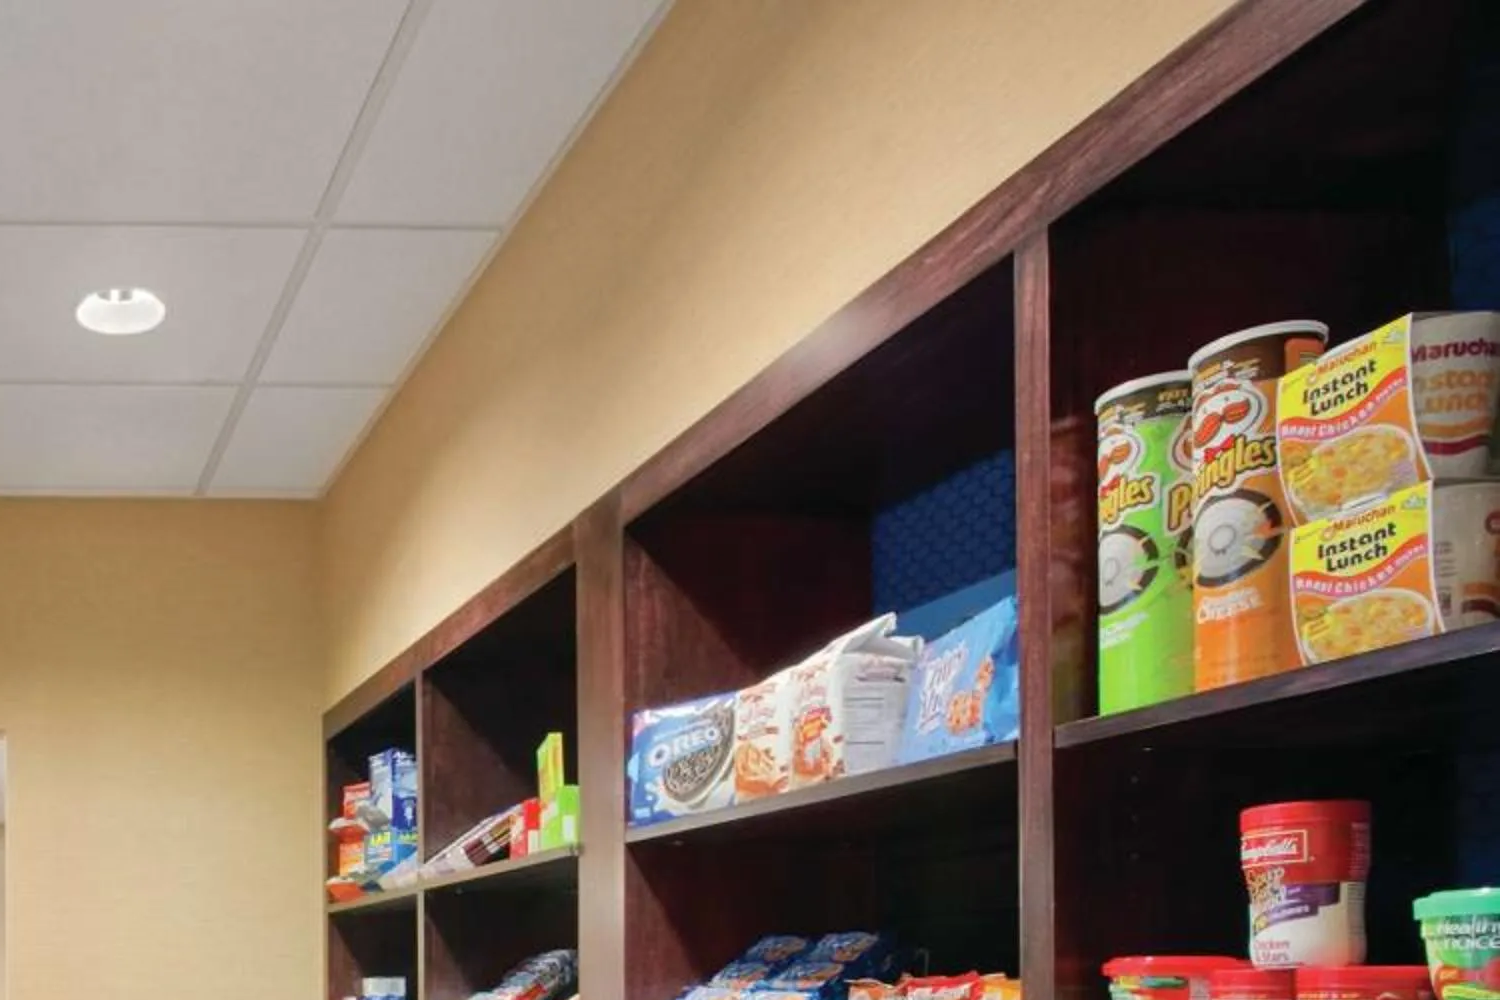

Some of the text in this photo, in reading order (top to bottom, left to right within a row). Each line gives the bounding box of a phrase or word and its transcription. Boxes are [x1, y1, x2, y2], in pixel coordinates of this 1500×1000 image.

[1316, 341, 1377, 375] Maruchan
[1303, 359, 1377, 404] Instant
[1310, 381, 1369, 416] Lunch
[1332, 505, 1396, 530] Maruchan
[1317, 522, 1397, 559] Instant
[1325, 544, 1389, 572] Lunch
[1334, 563, 1394, 593] Chicken
[646, 727, 720, 768] OREO
